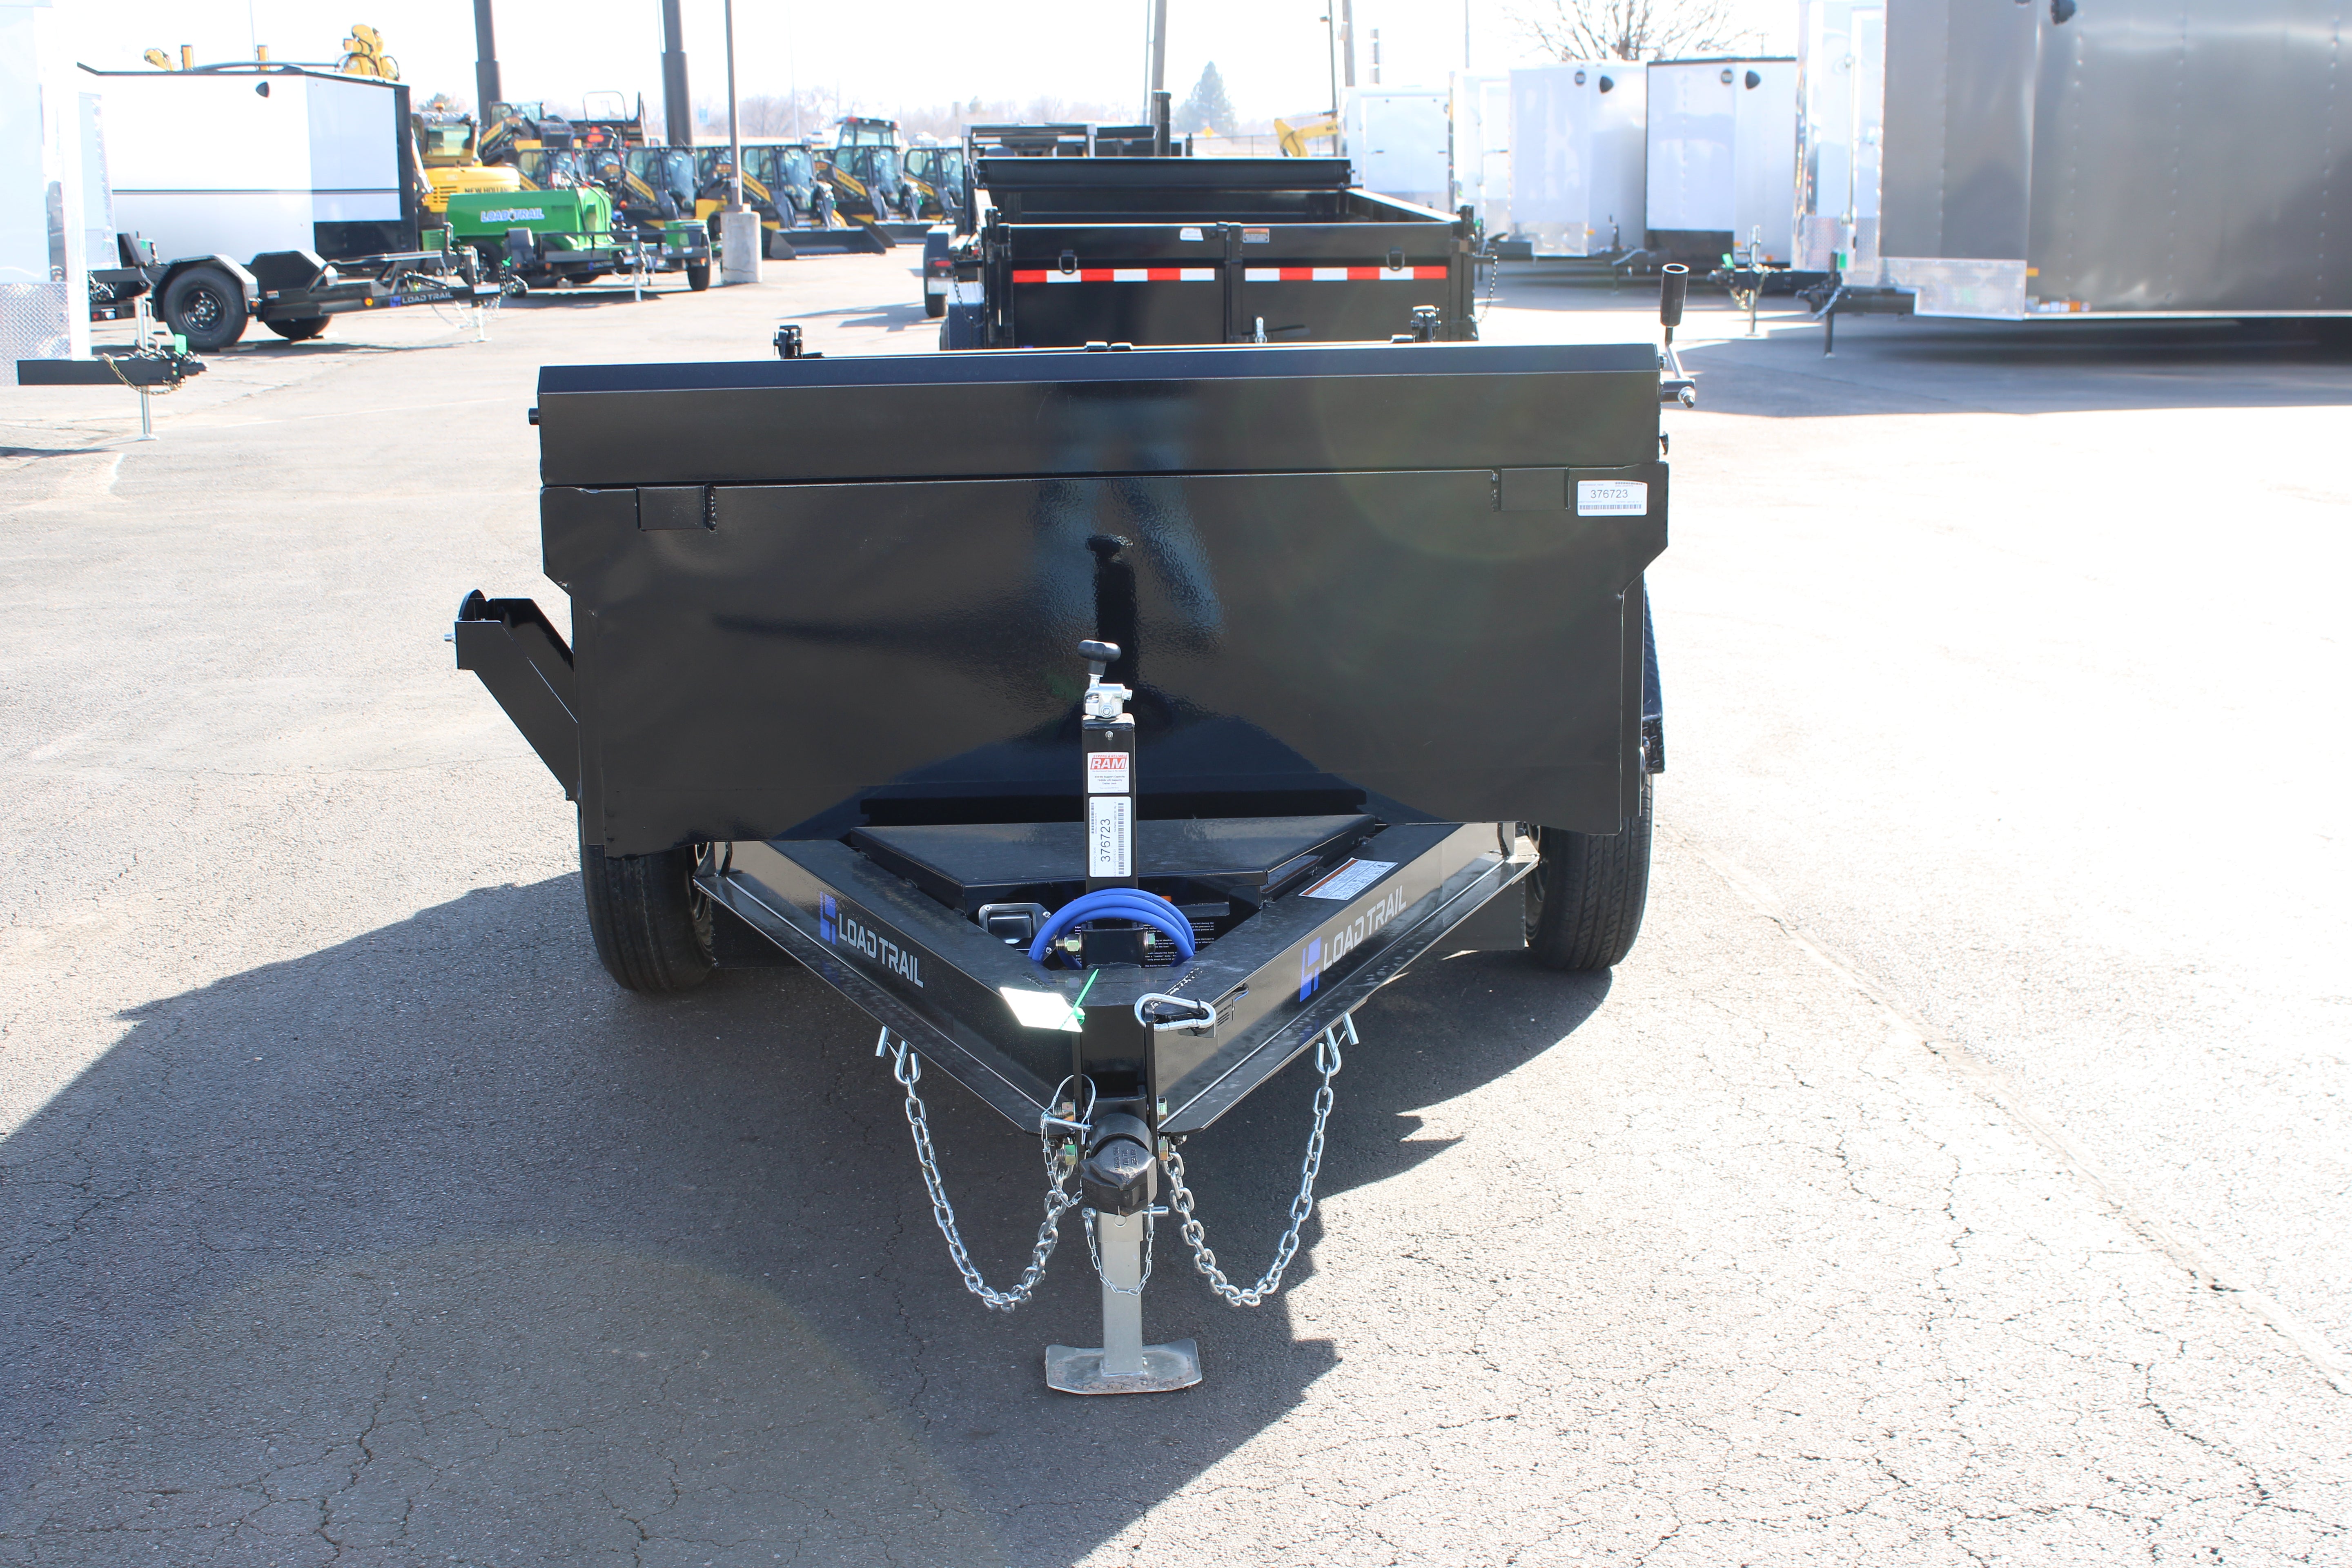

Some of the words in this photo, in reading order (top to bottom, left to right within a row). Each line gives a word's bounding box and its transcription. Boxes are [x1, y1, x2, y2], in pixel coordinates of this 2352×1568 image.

[481, 209, 510, 223] LOAD
[514, 207, 545, 219] TRAIL
[402, 295, 428, 304] LOAD
[428, 291, 454, 301] TRAIL
[1590, 489, 1628, 499] 376723
[1091, 758, 1126, 769] RAM
[1100, 818, 1111, 862] 376723
[1323, 915, 1365, 971] LOAD
[1367, 885, 1407, 935] TRAIL
[839, 913, 878, 959] LOAD
[879, 936, 924, 988] TRAIL
